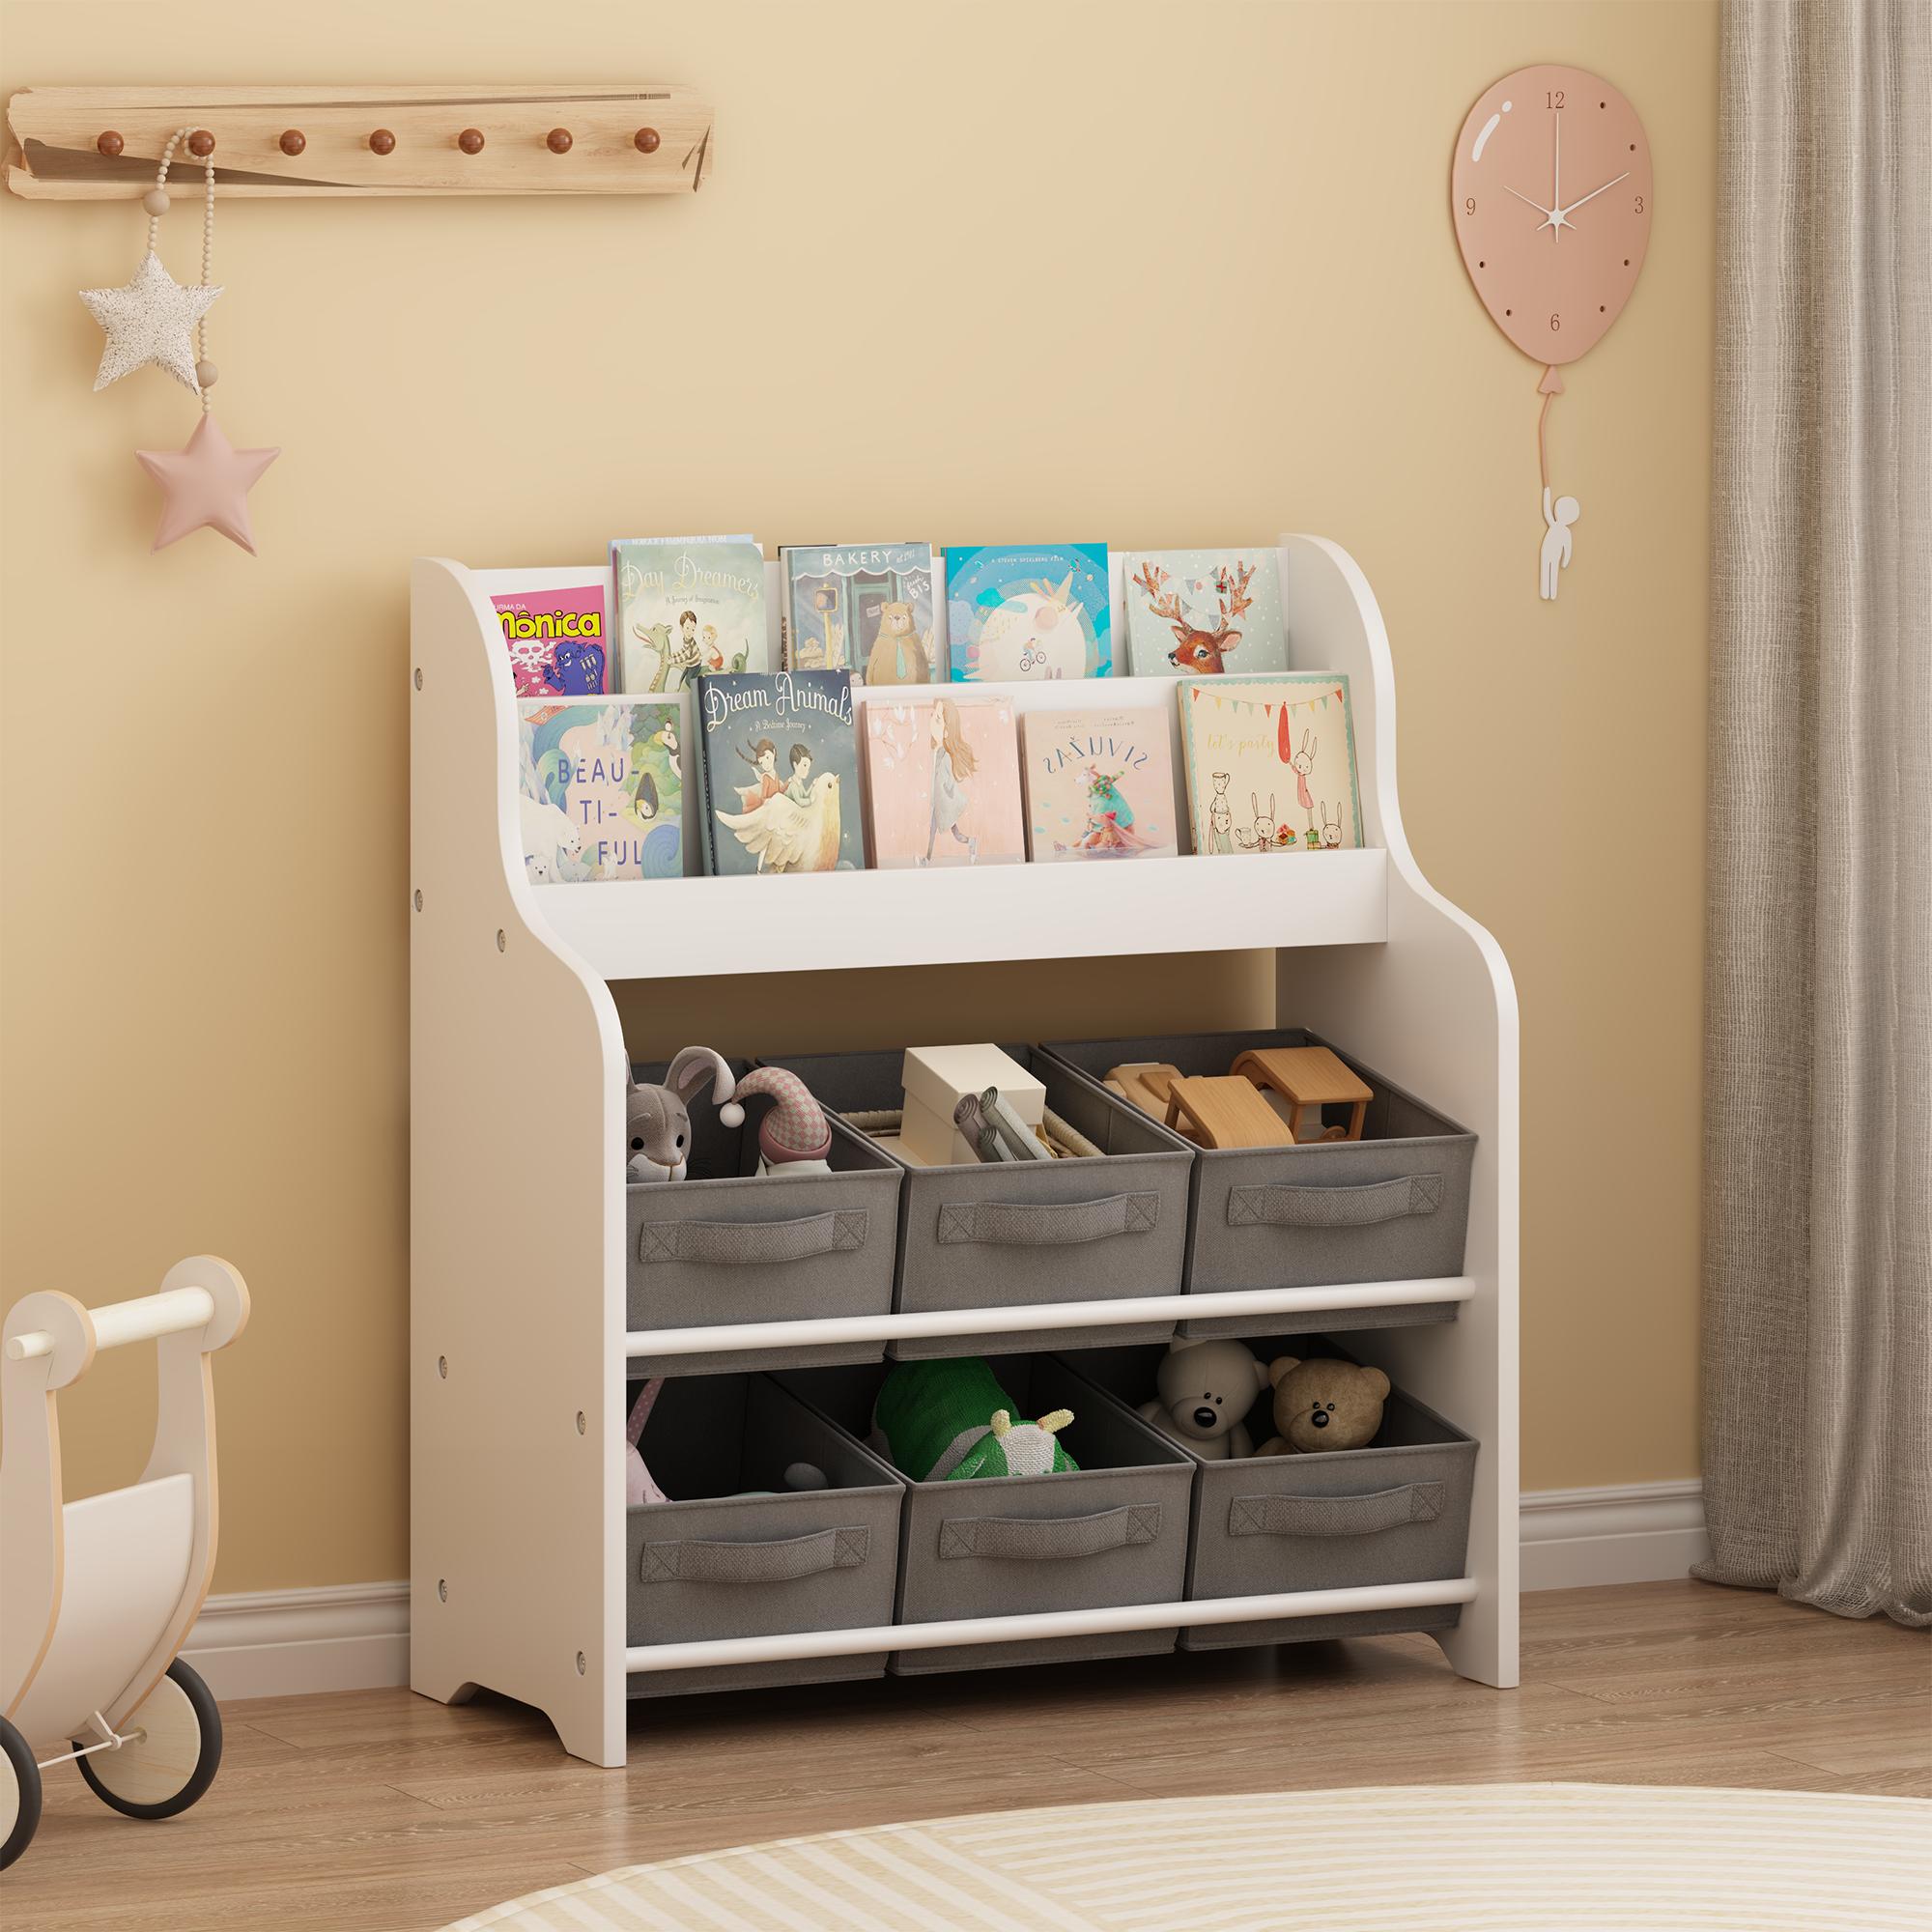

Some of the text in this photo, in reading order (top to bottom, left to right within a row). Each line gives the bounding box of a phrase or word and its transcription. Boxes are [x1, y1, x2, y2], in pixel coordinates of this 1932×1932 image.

[1546, 91, 1565, 109] 12
[1465, 197, 1477, 216] 9
[1634, 196, 1644, 214] 3
[1549, 313, 1560, 331] 6
[822, 550, 893, 567] BAKERY
[620, 550, 758, 602] Day Dreamers
[704, 671, 852, 732] Dream Animals
[1236, 734, 1274, 758] party
[557, 756, 640, 784] BEAU-
[579, 800, 618, 825] TI-
[598, 840, 642, 866] FUL
